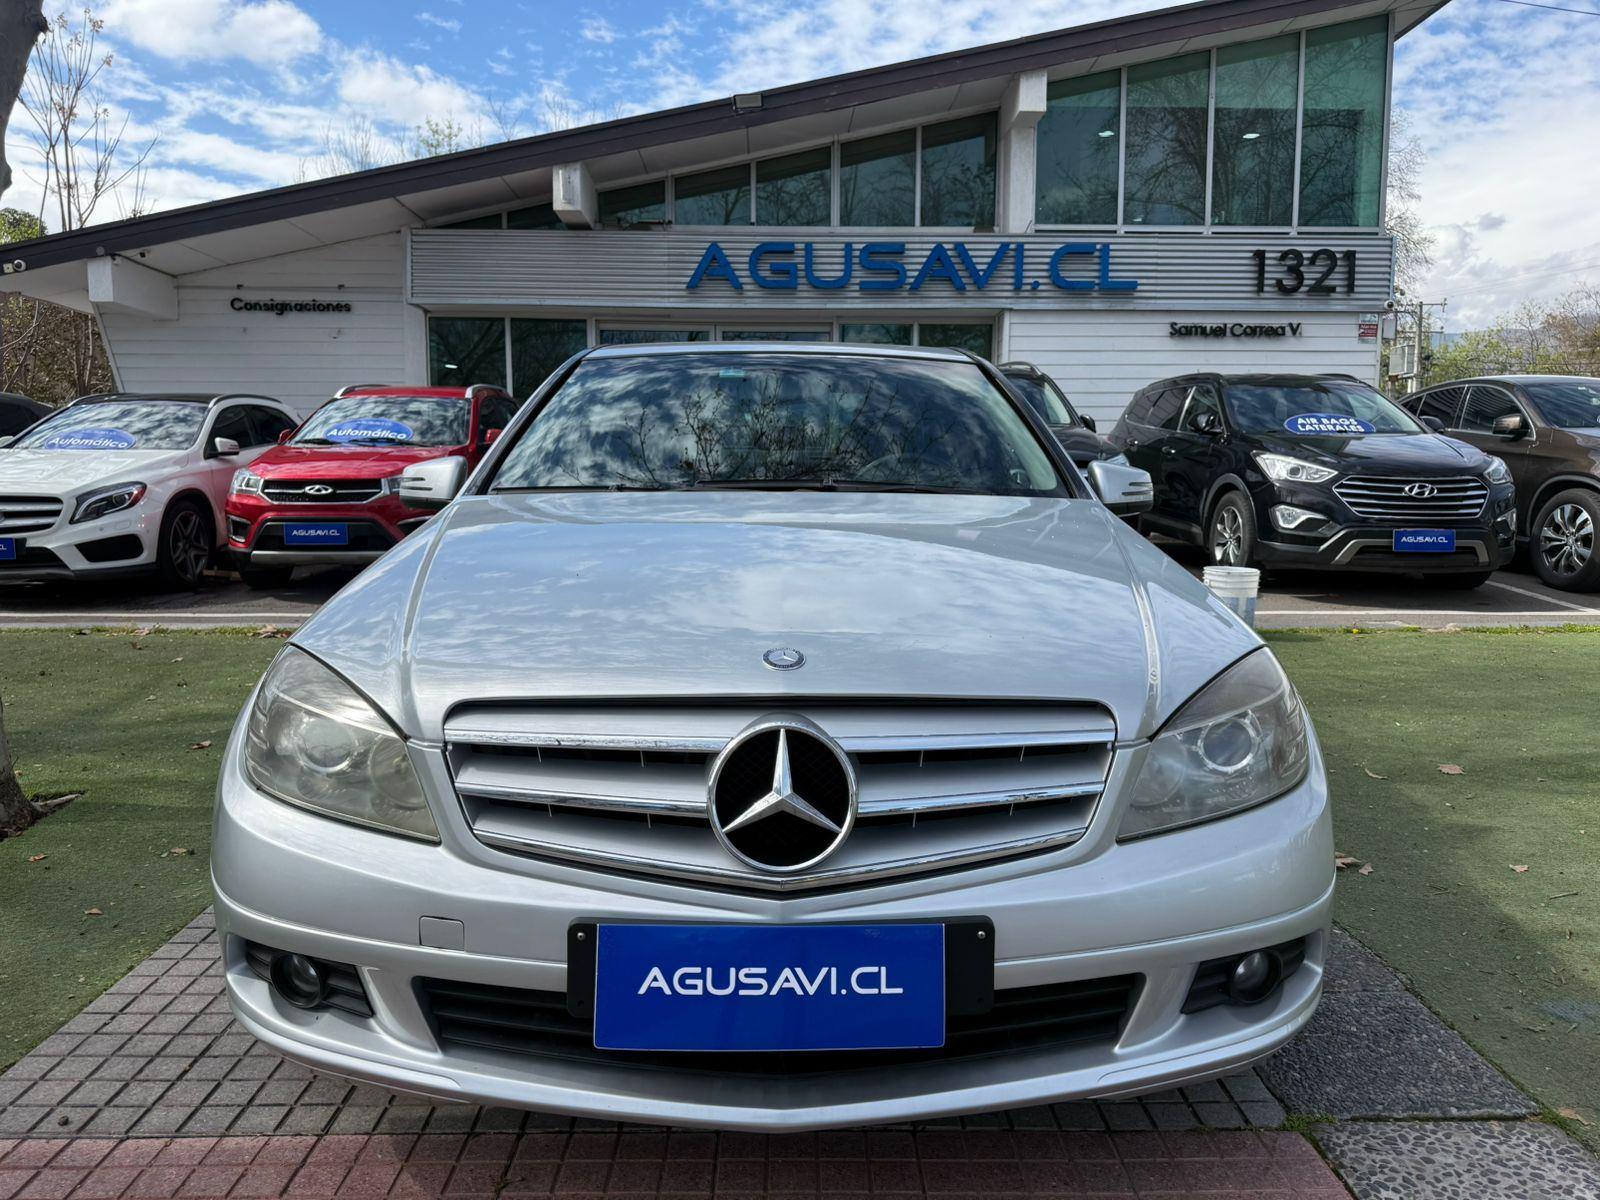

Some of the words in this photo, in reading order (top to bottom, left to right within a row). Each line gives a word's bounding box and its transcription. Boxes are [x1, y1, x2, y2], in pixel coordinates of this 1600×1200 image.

[686, 241, 1139, 291] AGUSAVI.CL
[1252, 249, 1357, 296] 1321
[230, 297, 351, 316] Consignaciones
[1169, 322, 1227, 337] Samuel
[1230, 323, 1285, 337] Correa
[1297, 417, 1319, 425] AIR
[1320, 417, 1358, 426] BAGS
[1297, 424, 1365, 433] LATERALES
[326, 427, 407, 440] Automático
[47, 437, 128, 448] Automático
[291, 529, 341, 537] AGUSAVI.CL
[637, 966, 904, 996] AGUSAVI.CL
